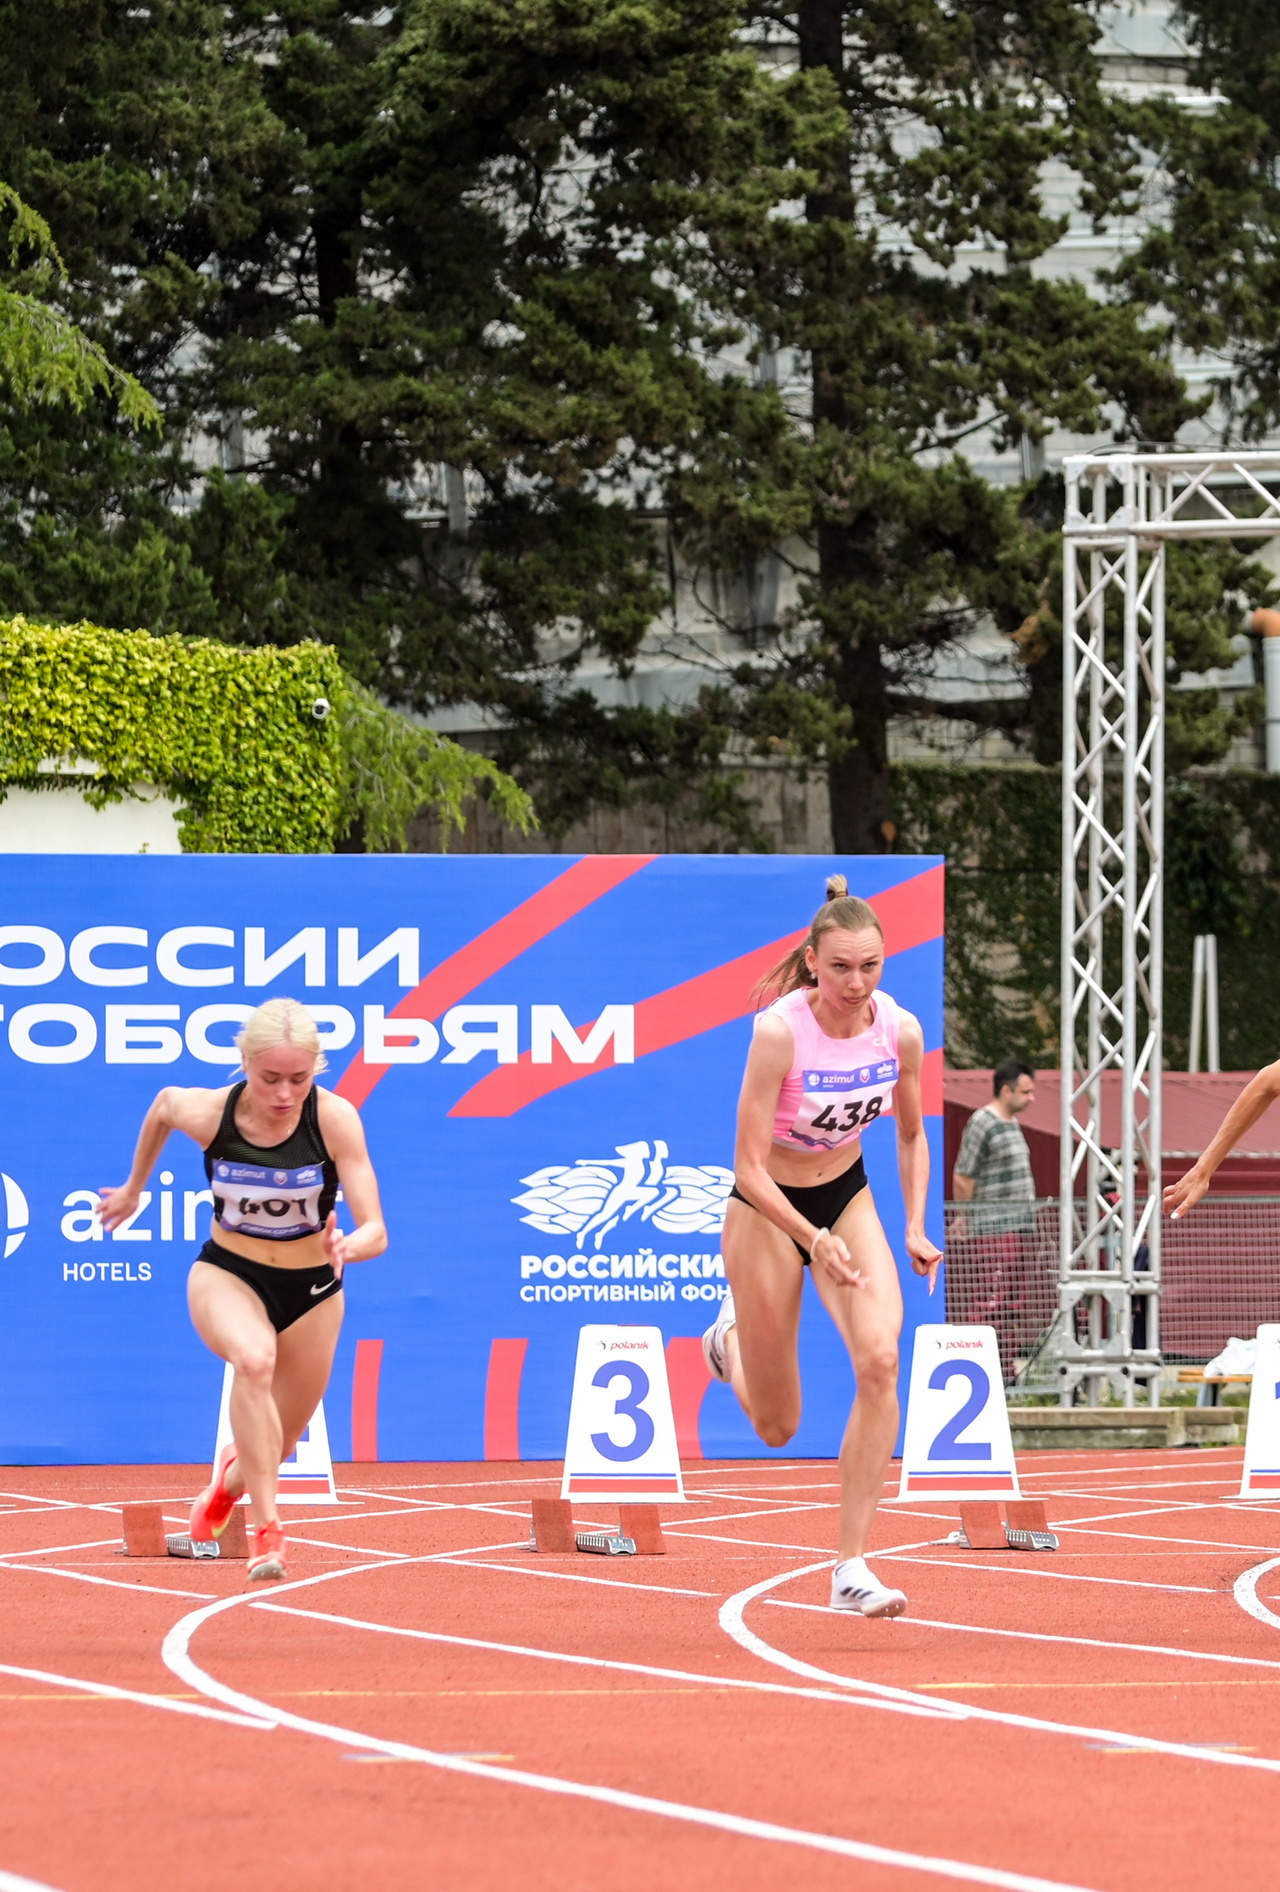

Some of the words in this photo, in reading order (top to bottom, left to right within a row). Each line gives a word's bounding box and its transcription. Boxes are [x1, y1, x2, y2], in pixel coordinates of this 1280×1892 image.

[0, 925, 420, 987] ОССИИ
[0, 1003, 635, 1064] ОБОРЬЯМ
[810, 1096, 883, 1132] 438
[231, 1168, 266, 1179] azimut
[63, 1262, 152, 1281] HOTELS
[520, 1248, 726, 1279] РОССИЙСКИ
[520, 1280, 676, 1302] СПОРТИВНЫЙ
[610, 1341, 649, 1351] polanik
[946, 1340, 984, 1350] polanik
[590, 1360, 655, 1462] 3
[927, 1359, 992, 1460] 2
